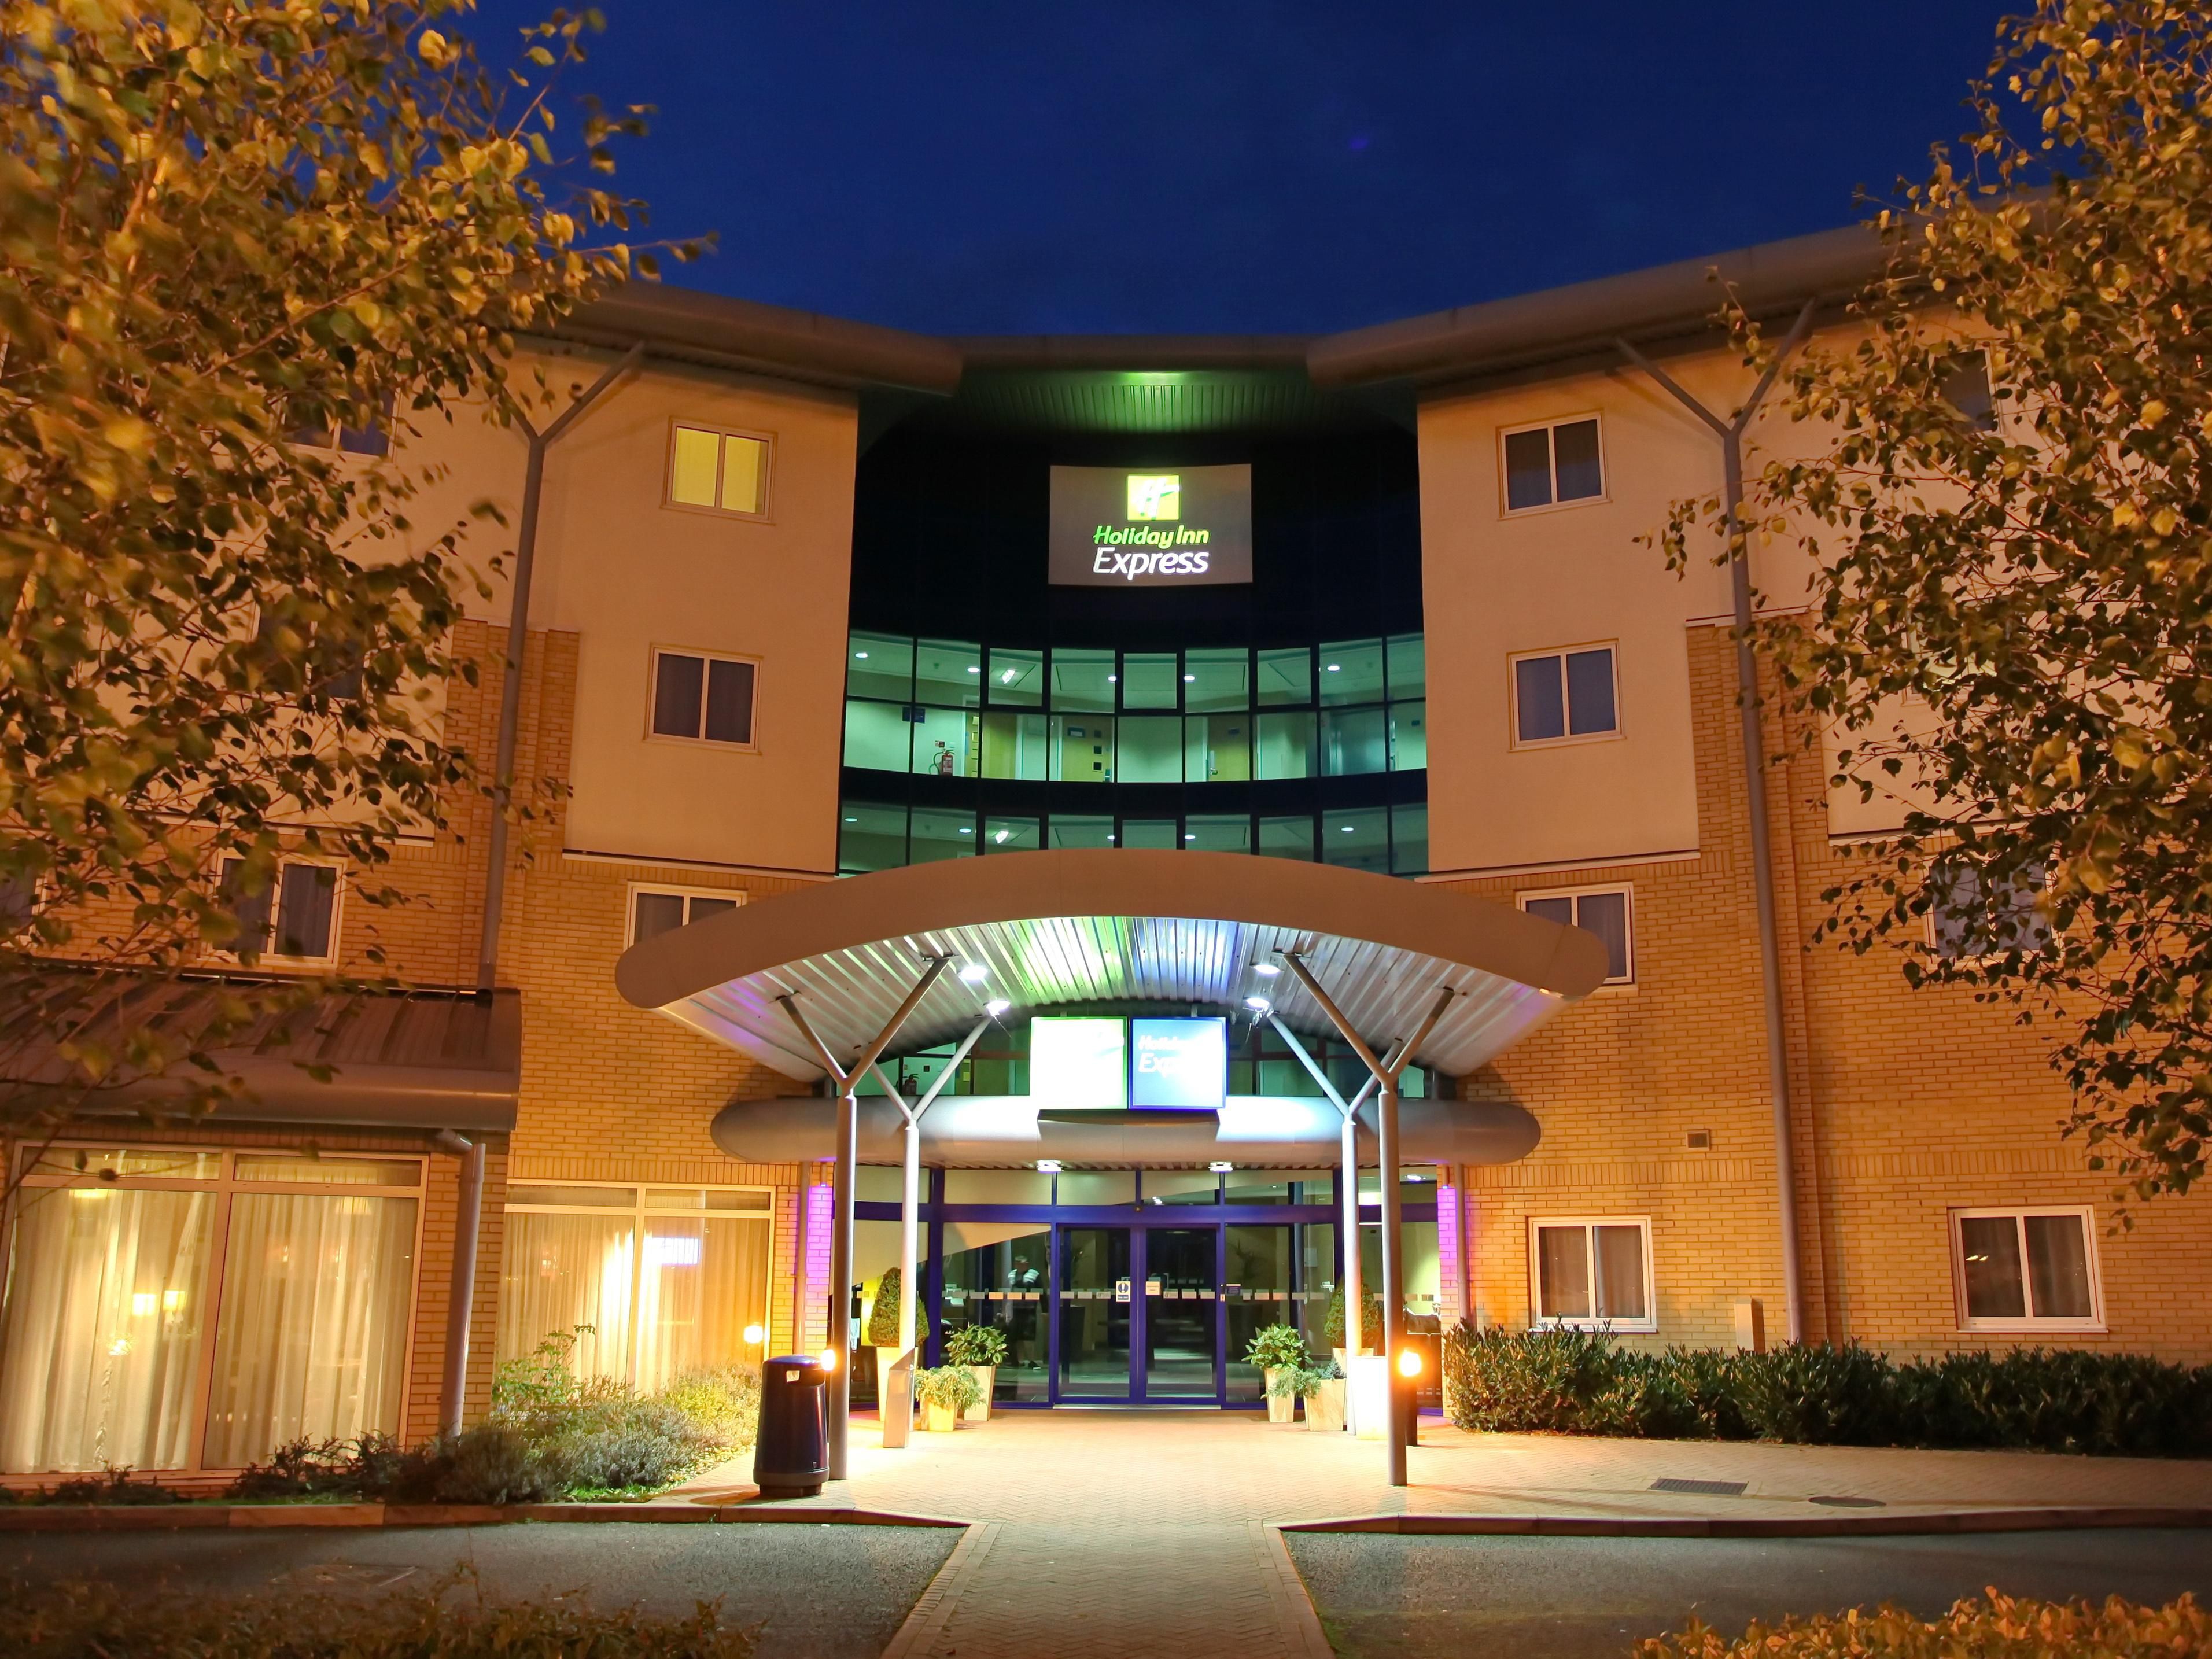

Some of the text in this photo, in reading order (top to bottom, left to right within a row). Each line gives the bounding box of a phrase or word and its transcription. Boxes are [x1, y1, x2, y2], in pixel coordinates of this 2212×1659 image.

[1093, 525, 1210, 549] Holiday Inn
[1093, 547, 1210, 581] Express
